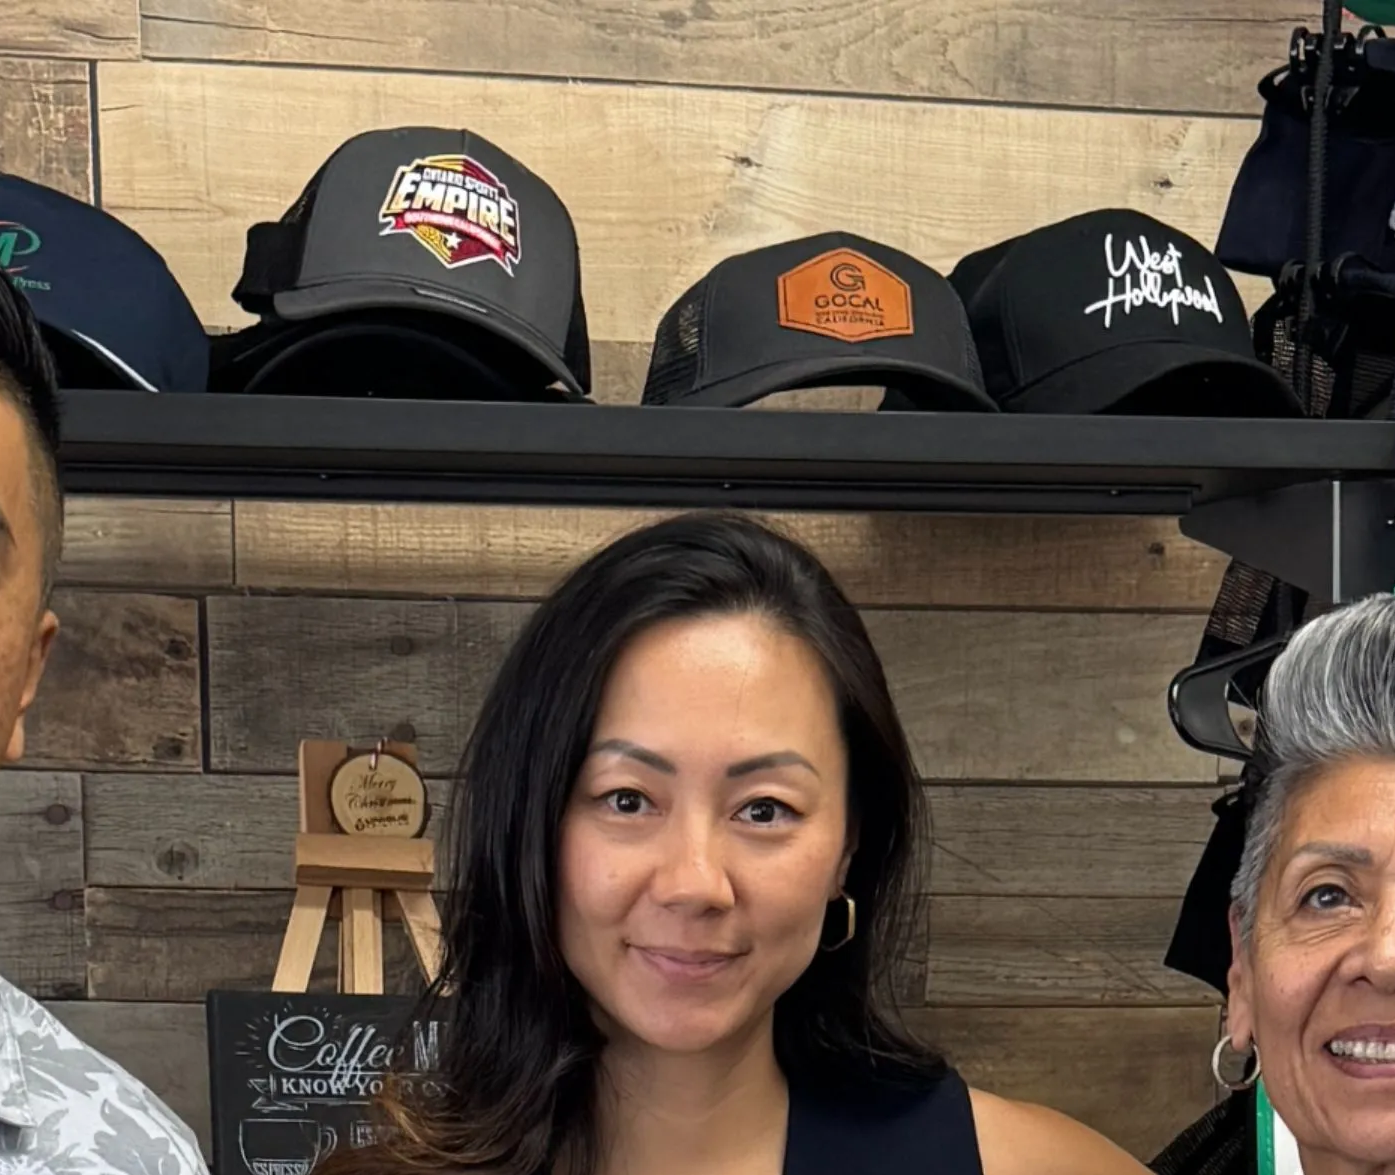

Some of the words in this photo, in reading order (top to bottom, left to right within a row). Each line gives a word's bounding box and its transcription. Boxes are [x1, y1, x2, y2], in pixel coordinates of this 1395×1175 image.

[389, 171, 516, 247] EMPIRE
[1104, 233, 1184, 288] West
[814, 294, 885, 312] GOCAL
[280, 1076, 347, 1097] KNOW
